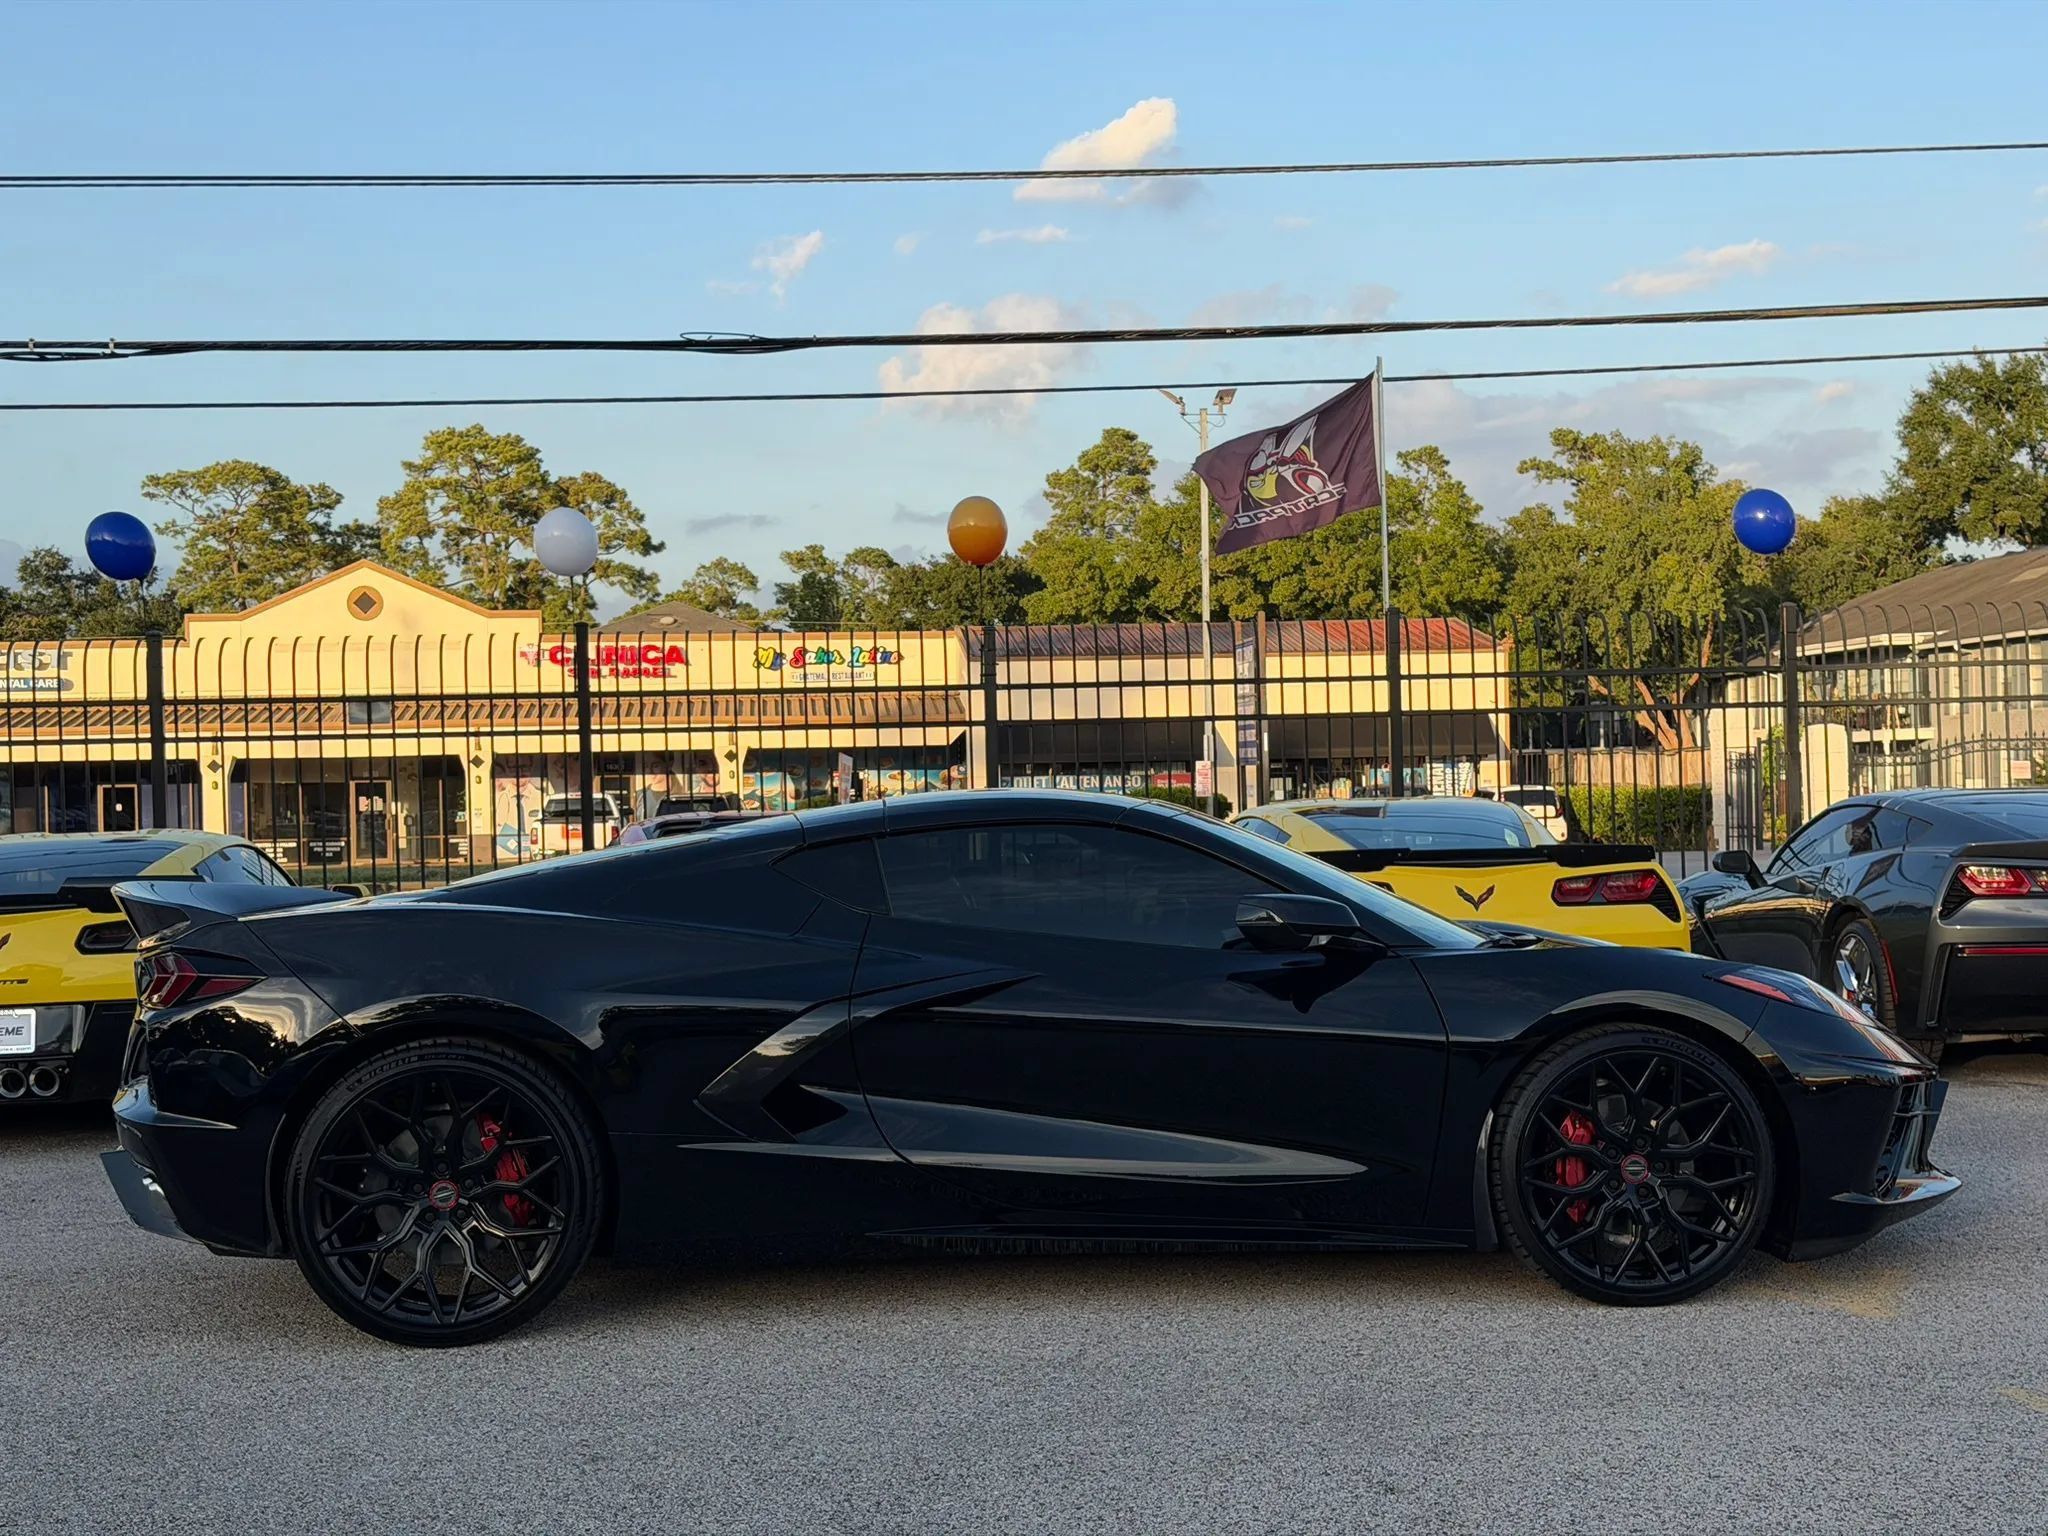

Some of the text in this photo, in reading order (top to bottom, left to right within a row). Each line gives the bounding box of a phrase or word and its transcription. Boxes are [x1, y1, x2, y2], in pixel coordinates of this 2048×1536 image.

[549, 645, 689, 666] CNICA
[847, 646, 904, 668] Latino
[30, 678, 59, 688] CARE
[0, 1026, 25, 1036] EME
